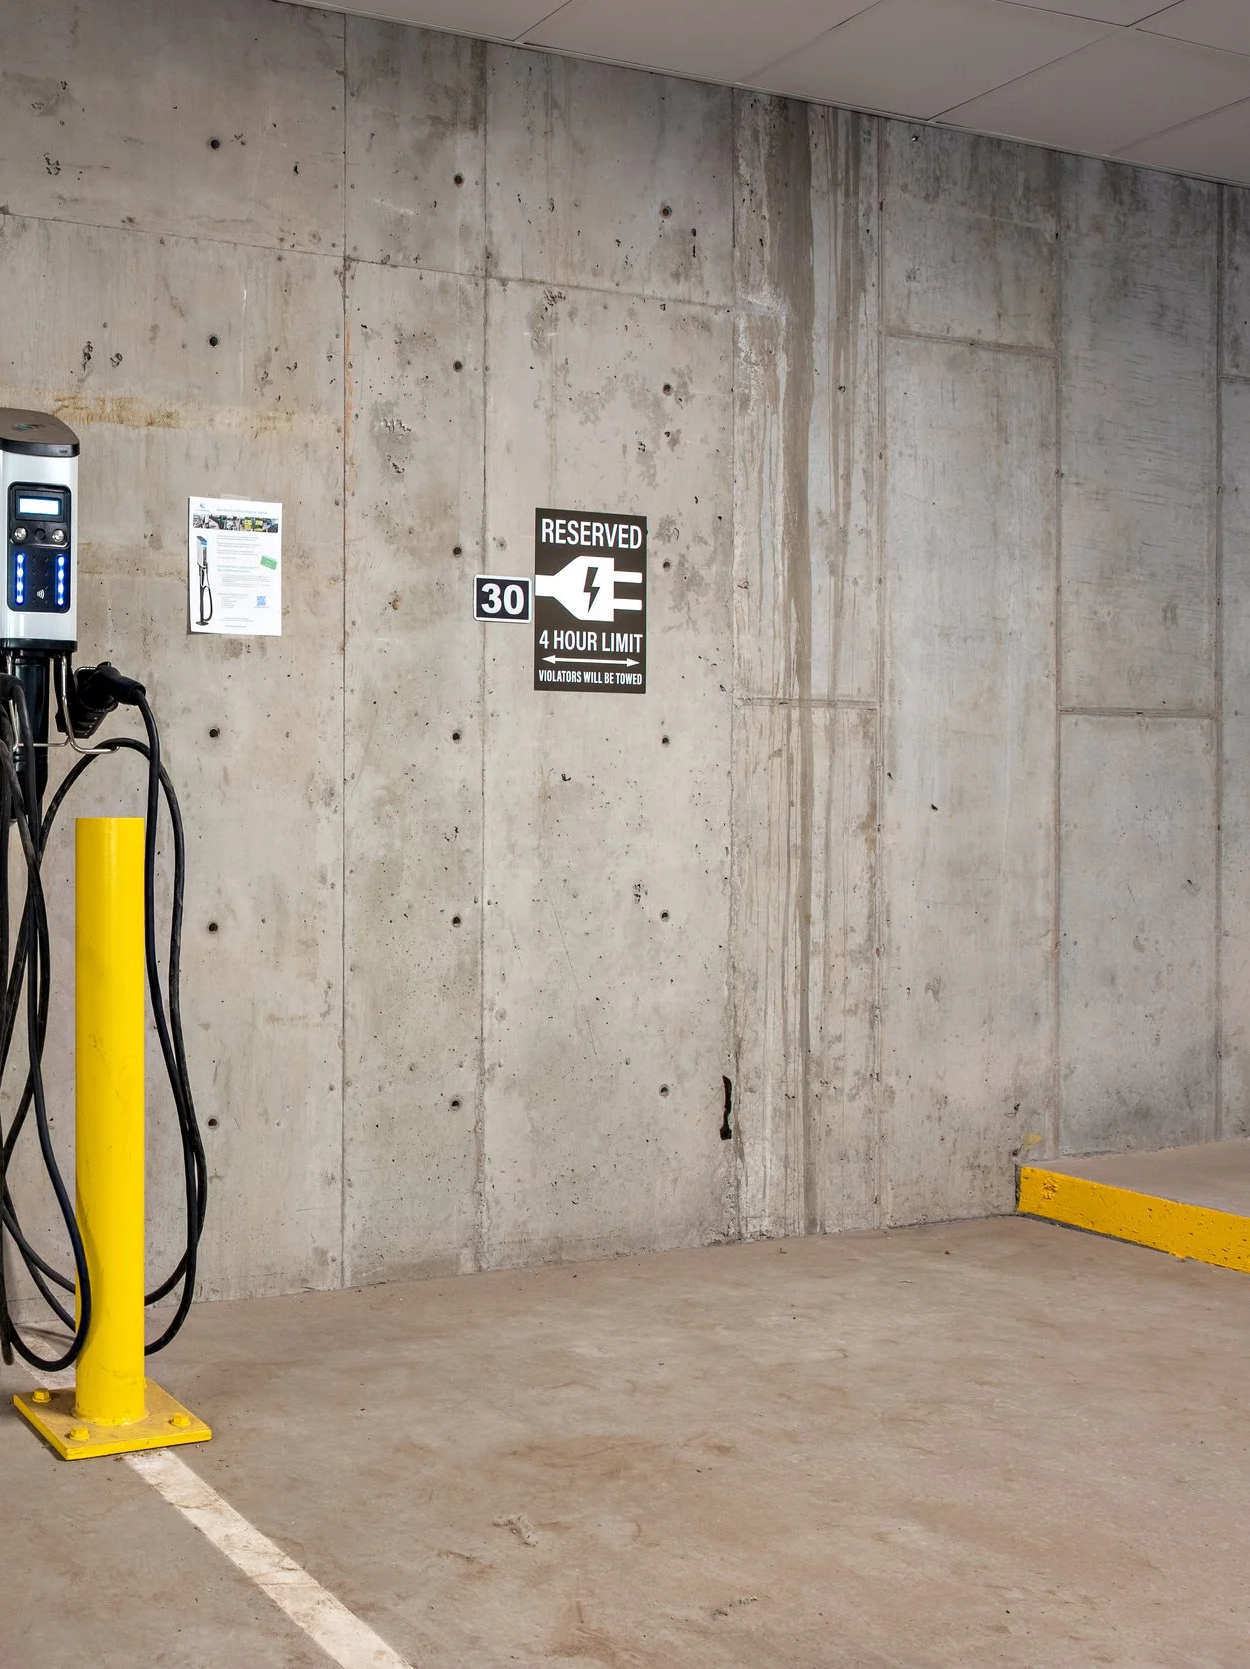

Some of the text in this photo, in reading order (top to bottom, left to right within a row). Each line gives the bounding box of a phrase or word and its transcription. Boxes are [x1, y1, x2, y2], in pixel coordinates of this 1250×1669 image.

[541, 518, 642, 549] RESERVED
[481, 583, 525, 615] 30
[539, 630, 643, 653] 4 HOUR LIMIT
[538, 670, 642, 685] VIOLATORS WILL BE TOWED
